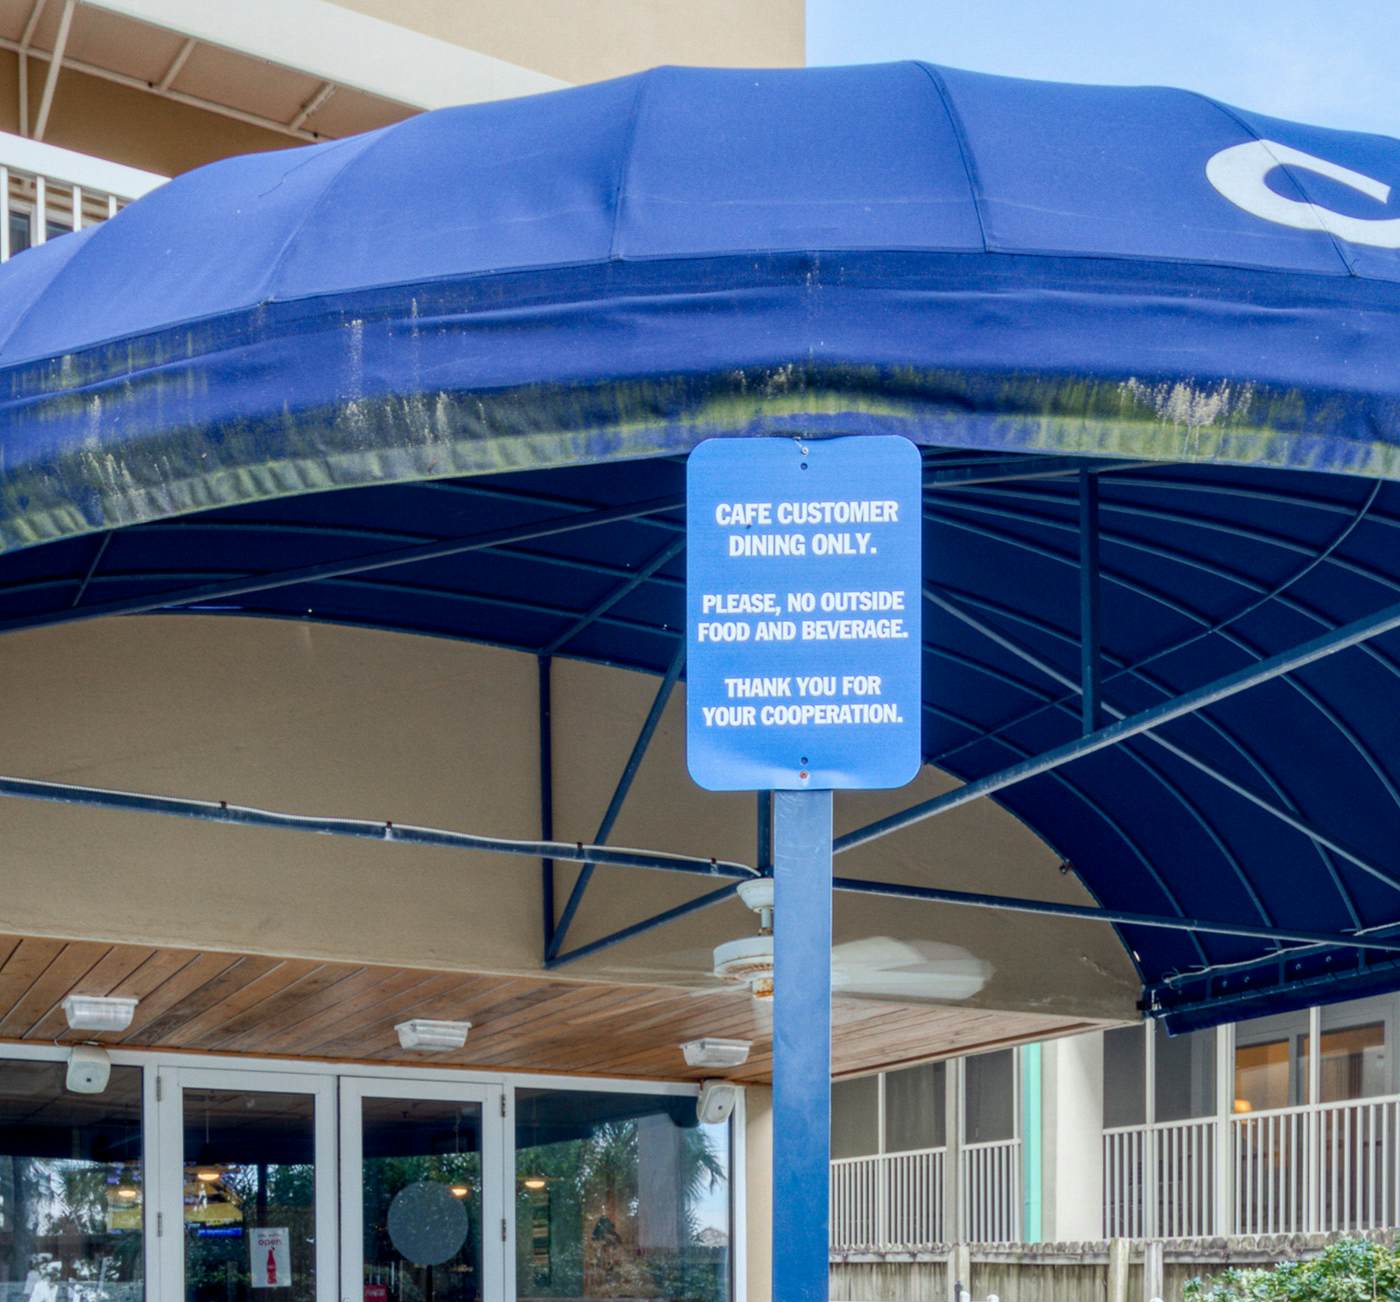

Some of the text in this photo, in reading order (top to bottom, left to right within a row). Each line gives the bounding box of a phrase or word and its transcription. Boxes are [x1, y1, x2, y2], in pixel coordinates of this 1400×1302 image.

[715, 500, 899, 526] CAFE CUSTOMER
[729, 532, 877, 557] DINING ONLY.
[702, 590, 905, 617] PLEASE, NO OUTSIDE
[698, 618, 909, 642] FOOD AND BEVERAGE.
[724, 675, 882, 698] THANK YOU FOR
[702, 703, 903, 727] YOUR COOPERATION.
